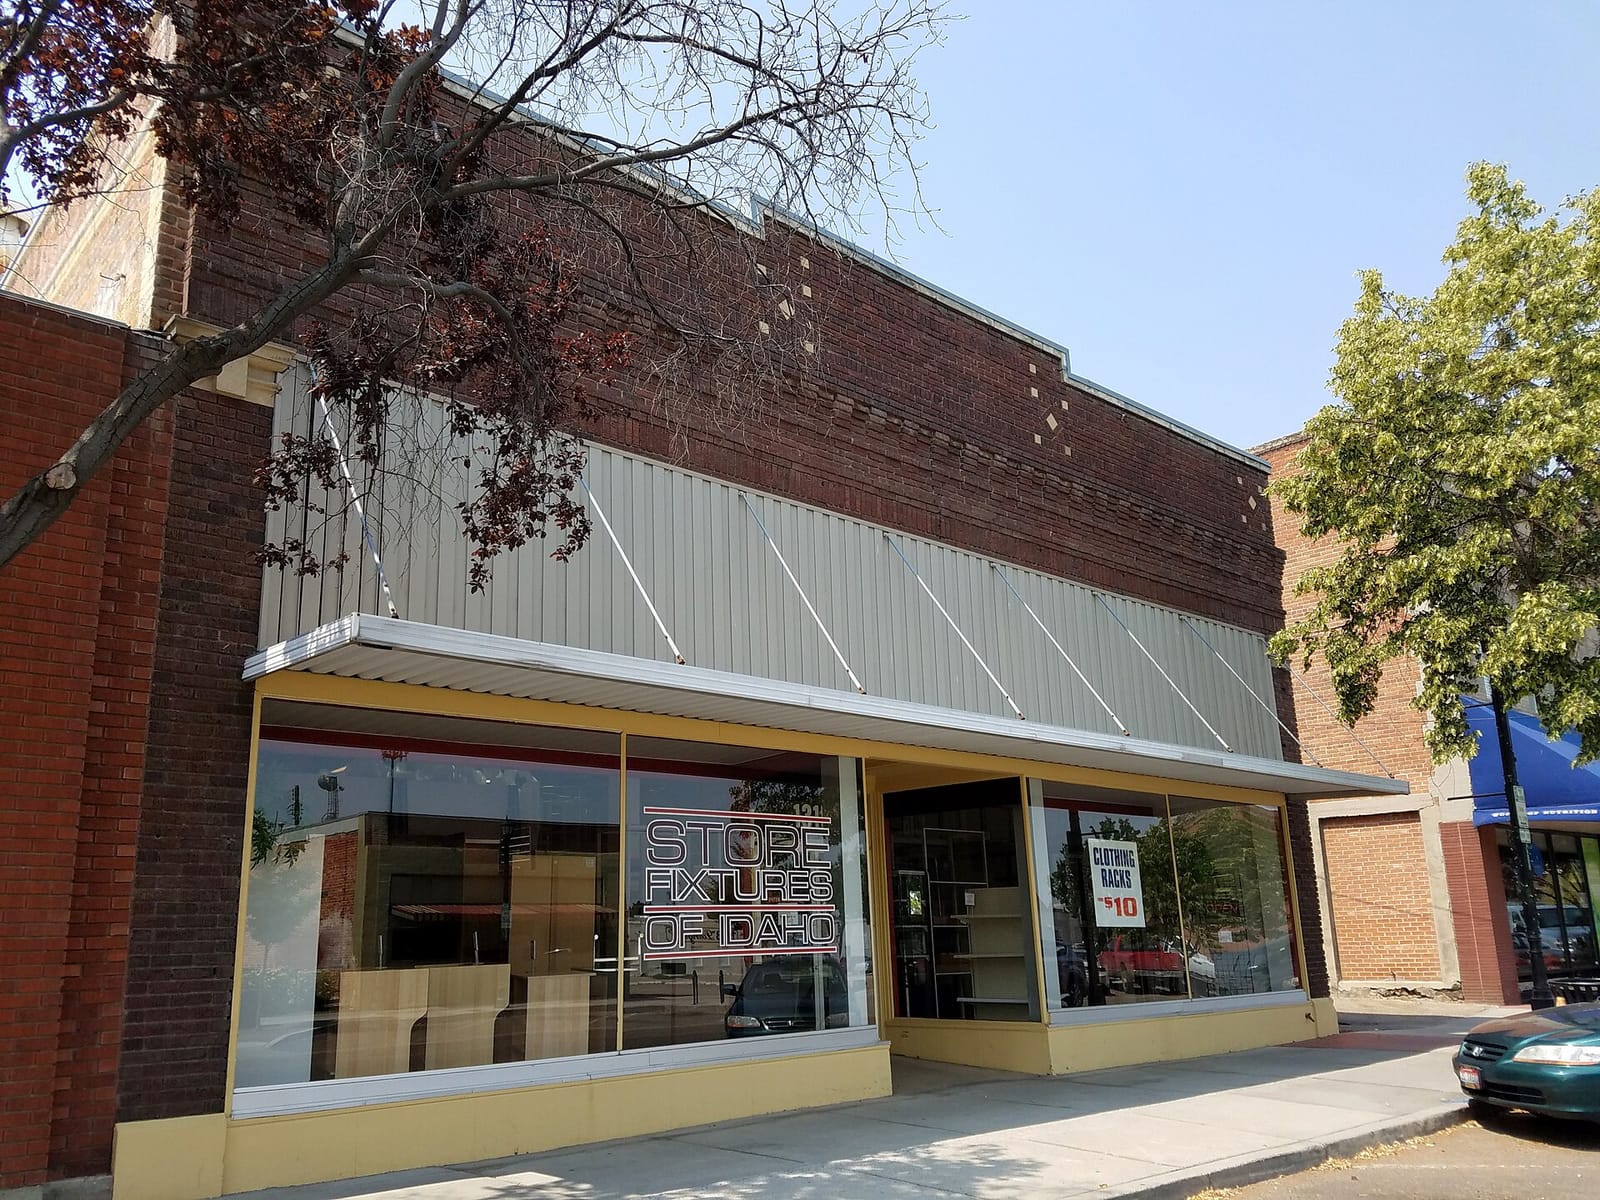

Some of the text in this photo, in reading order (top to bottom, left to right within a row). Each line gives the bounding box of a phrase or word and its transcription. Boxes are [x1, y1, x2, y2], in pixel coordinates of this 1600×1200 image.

[646, 818, 832, 869] STORE
[1093, 847, 1136, 868] CLOTHING
[645, 867, 834, 902] FIXTURES
[1101, 868, 1132, 889] RACKS
[645, 914, 703, 949] OF
[719, 913, 835, 947] IDAHO
